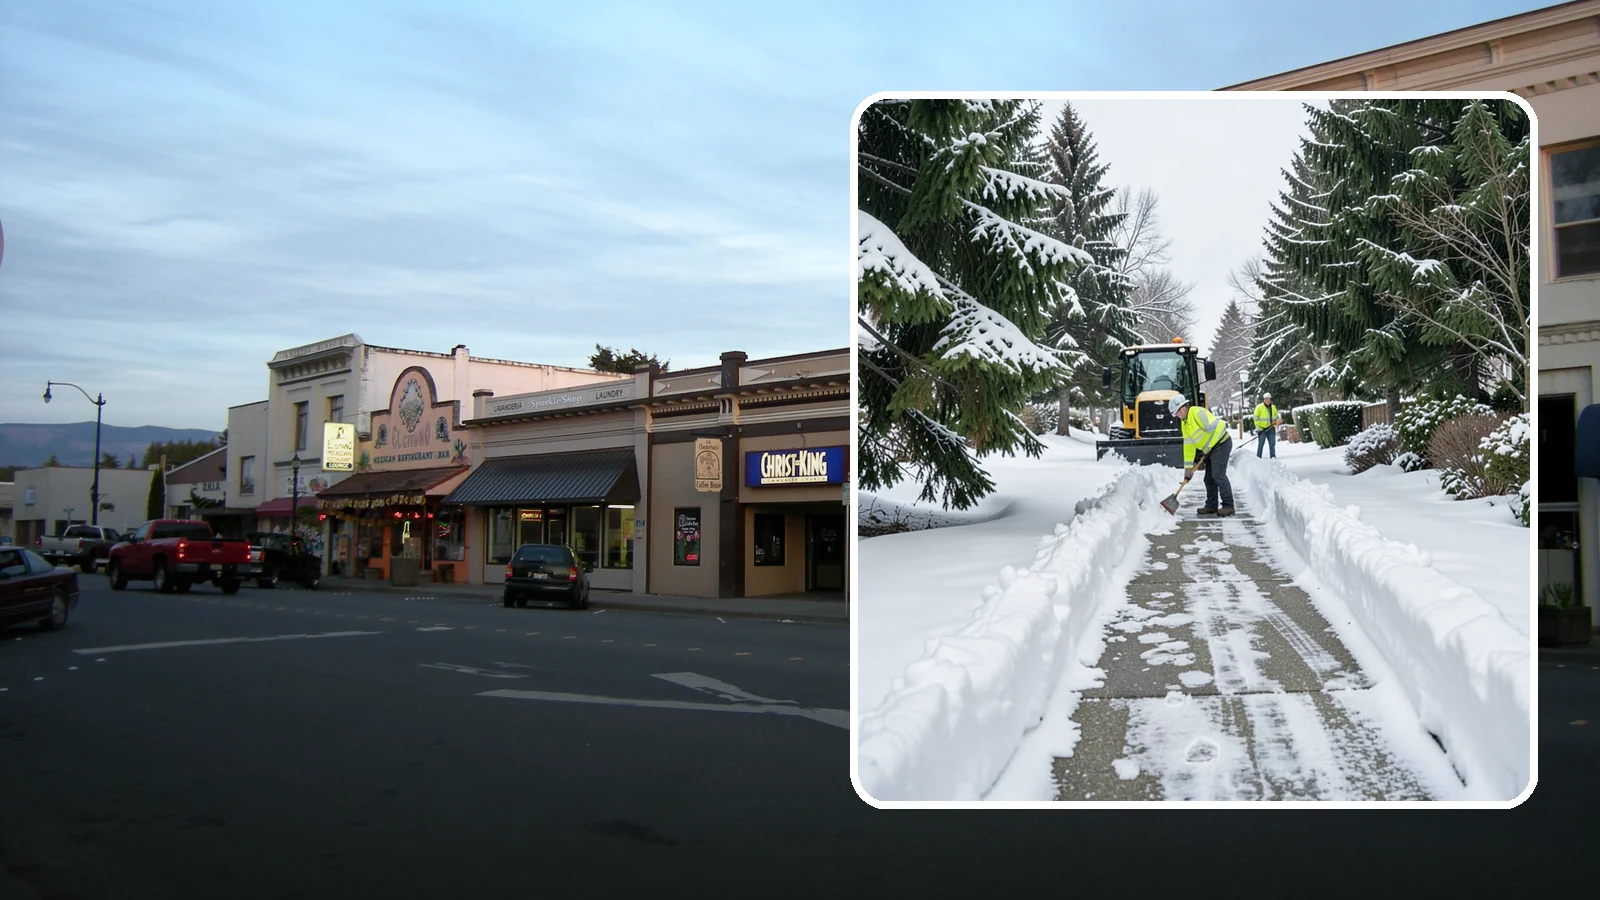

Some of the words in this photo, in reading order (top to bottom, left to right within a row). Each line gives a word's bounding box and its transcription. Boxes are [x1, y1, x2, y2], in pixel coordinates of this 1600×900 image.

[494, 402, 522, 413] LAVANDERIA
[531, 397, 561, 409] Sparkle
[562, 394, 582, 404] Shop
[595, 389, 623, 400] LAUNDRY
[374, 455, 396, 464] MEXICAN
[398, 452, 433, 462] RESTAURANT
[438, 450, 450, 459] BAR
[761, 452, 797, 478] CHRIST
[799, 450, 827, 476] KING
[696, 480, 709, 489] Coffee
